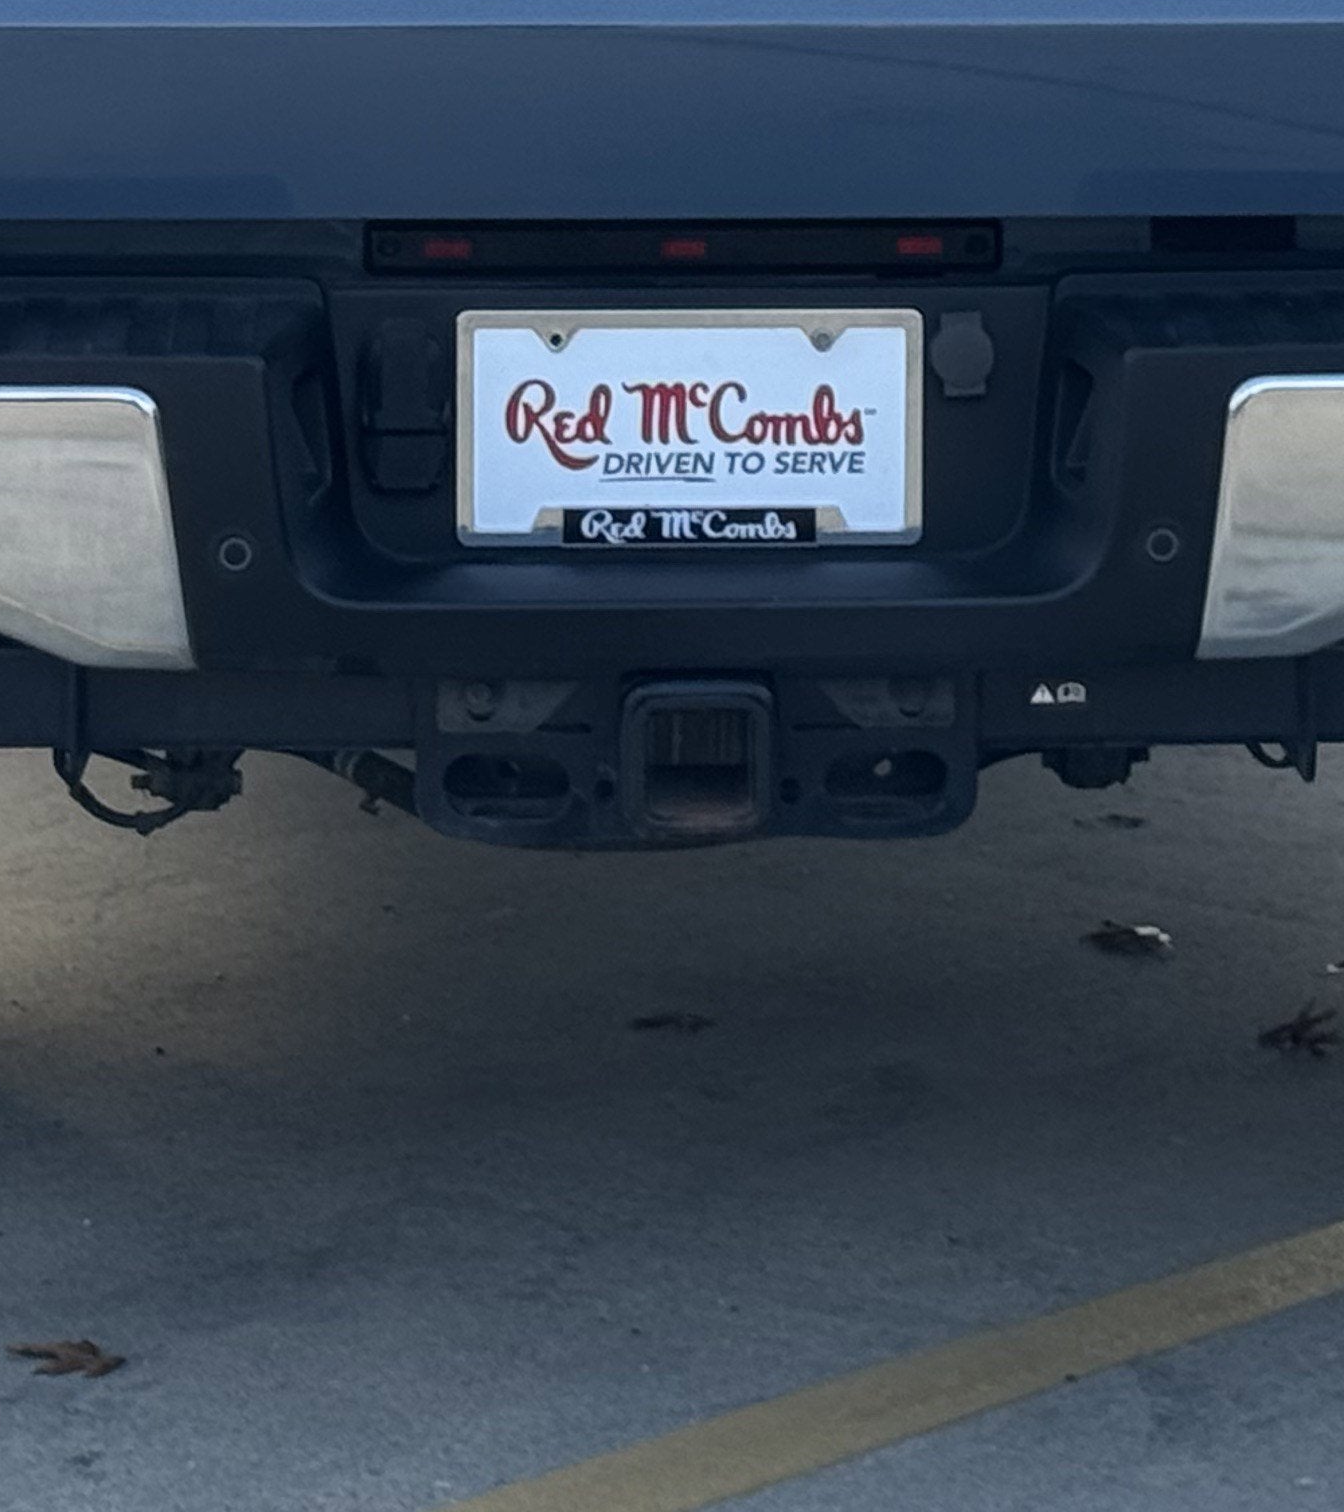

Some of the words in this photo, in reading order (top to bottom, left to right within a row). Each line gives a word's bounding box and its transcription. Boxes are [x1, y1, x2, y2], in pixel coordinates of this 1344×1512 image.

[505, 379, 613, 471] Red
[621, 381, 864, 446] McCombs
[602, 452, 715, 476] DRIVEN
[724, 452, 765, 475] TO
[774, 451, 866, 475] SERVE
[580, 509, 647, 544] Red
[651, 509, 798, 539] McCombs
